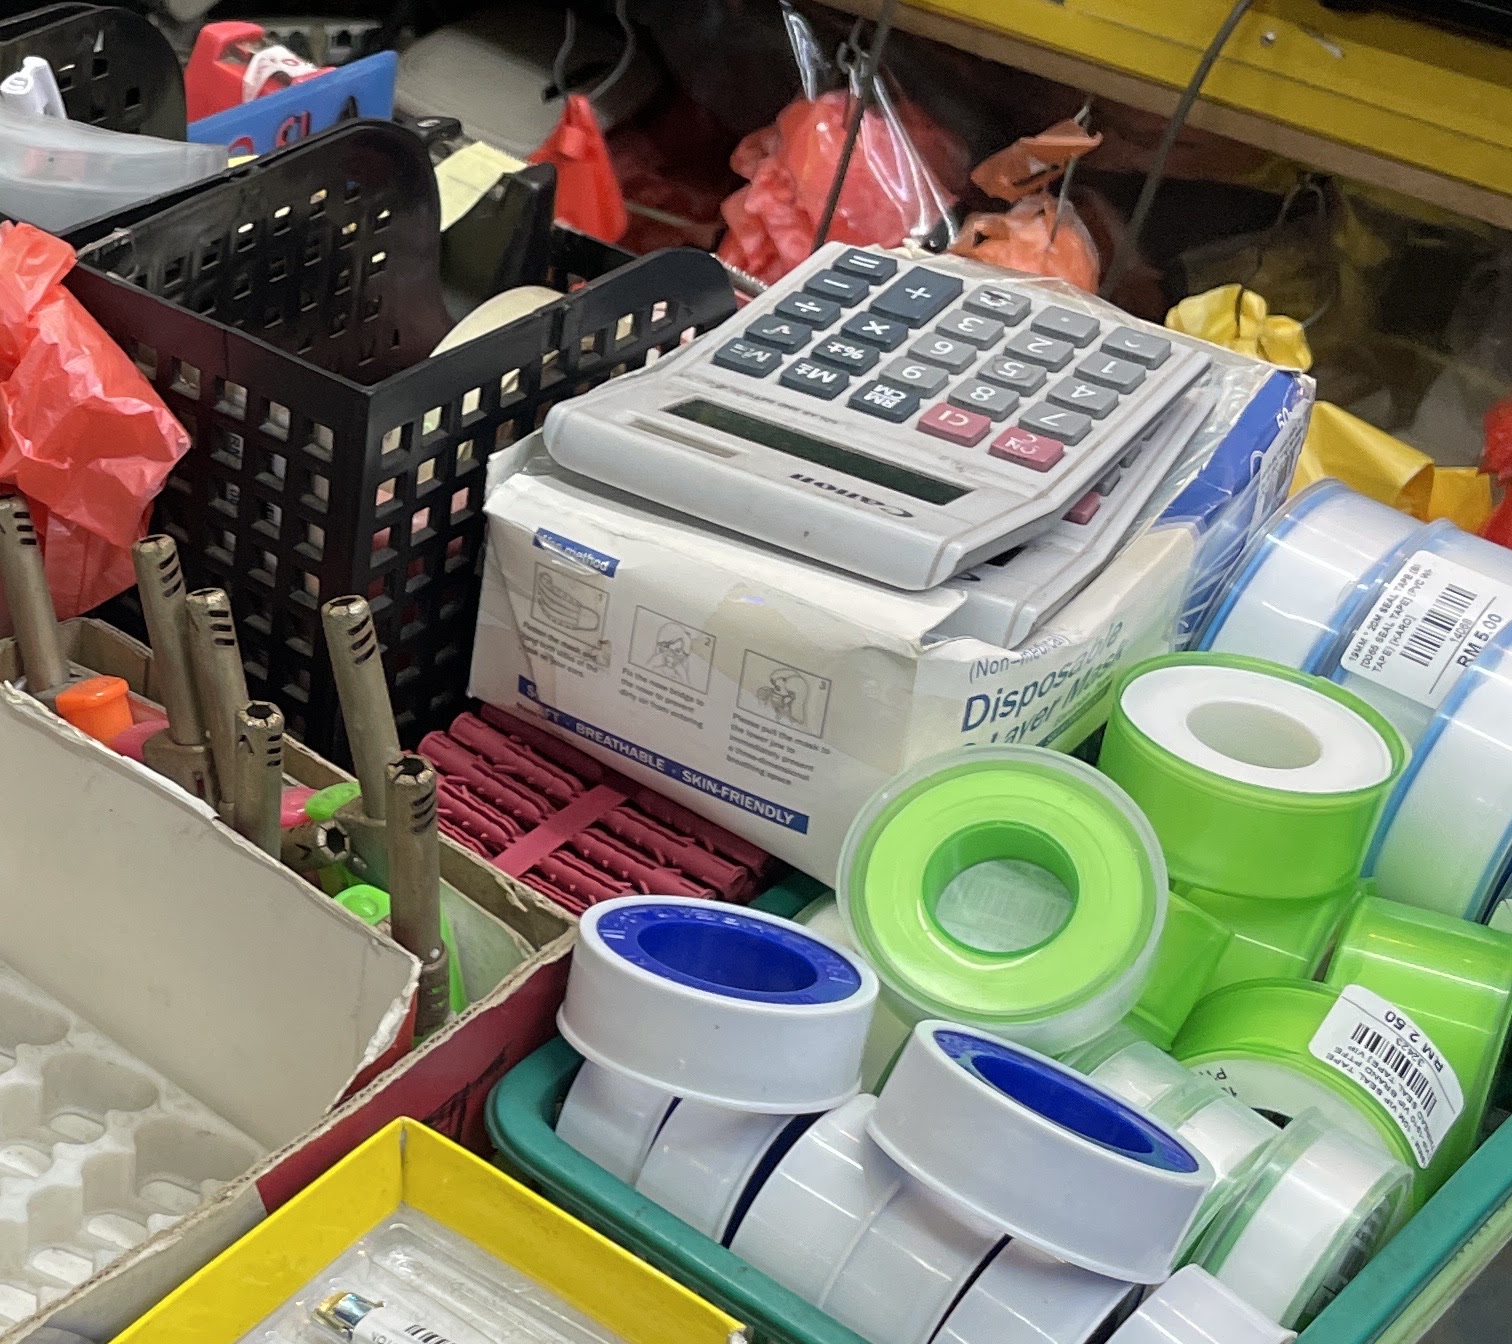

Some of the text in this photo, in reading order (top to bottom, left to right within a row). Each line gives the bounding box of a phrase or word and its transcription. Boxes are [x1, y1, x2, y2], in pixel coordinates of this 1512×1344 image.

[957, 314, 985, 333] 3
[1025, 337, 1054, 354] 2
[928, 339, 1097, 403] 6 5 4
[968, 384, 995, 403] 8
[790, 471, 916, 520] Canon
[1379, 594, 1400, 614] SEAL
[1393, 575, 1414, 593] TAPE
[1376, 622, 1396, 644] SEAL
[1456, 612, 1503, 668] RM 5.00
[525, 683, 562, 723] SFT
[575, 721, 666, 773] BREATHABLE
[680, 768, 795, 825] SKIN-FRIENDLY
[1383, 1009, 1444, 1073] RM 2.50
[1324, 1052, 1355, 1074] TAPE
[1332, 1046, 1397, 1099] BRAND PTFE
[1358, 1071, 1383, 1096] SEAL
[1397, 1083, 1418, 1109] SEAL
